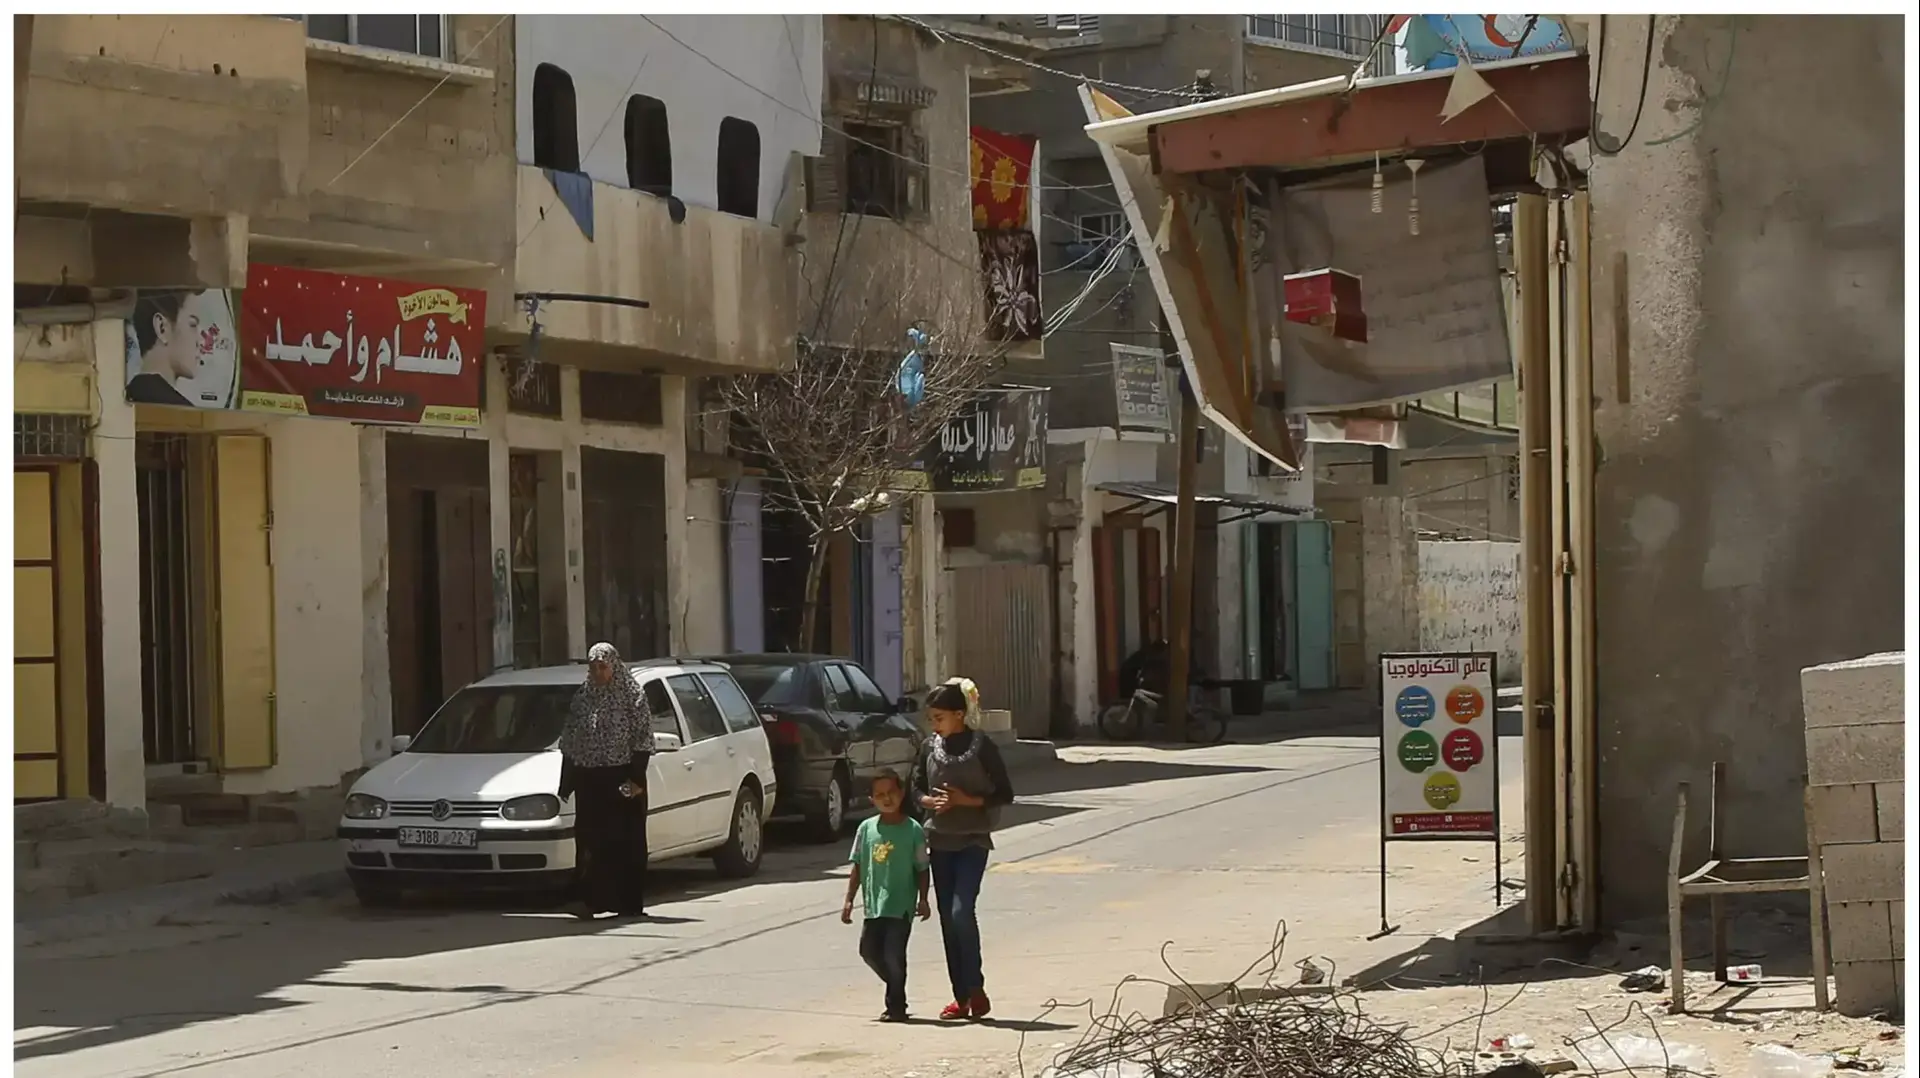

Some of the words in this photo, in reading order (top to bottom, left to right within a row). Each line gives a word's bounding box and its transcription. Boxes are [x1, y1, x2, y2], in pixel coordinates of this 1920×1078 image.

[265, 309, 370, 383] وأحمد
[376, 317, 463, 385] هشام
[990, 411, 1016, 453] عماد
[1387, 656, 1459, 679] التكنولوجيا
[1463, 656, 1487, 681] عالم
[415, 829, 440, 845] 3188
[450, 830, 464, 845] 22
